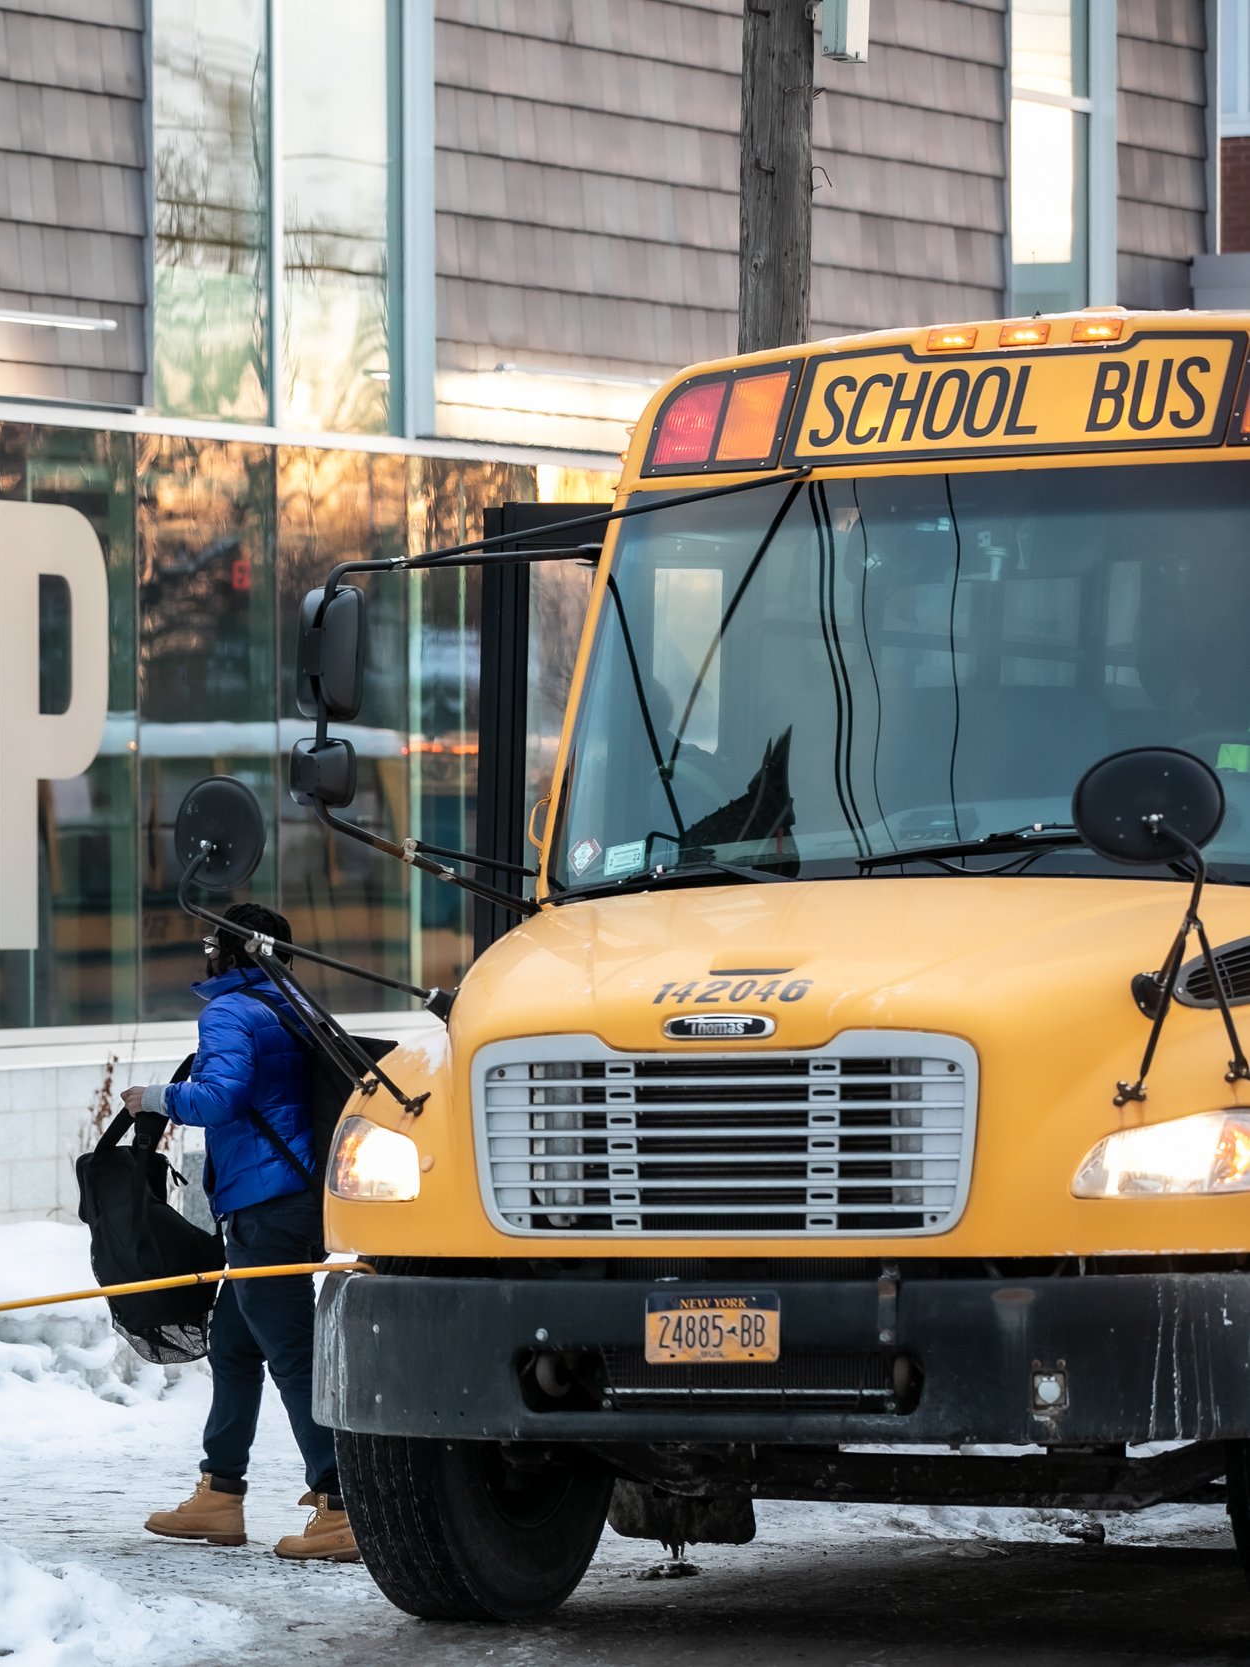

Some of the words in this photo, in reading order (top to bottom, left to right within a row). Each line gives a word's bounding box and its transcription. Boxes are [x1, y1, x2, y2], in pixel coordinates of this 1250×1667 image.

[808, 364, 1038, 448] SCHOOL
[1084, 355, 1211, 433] BUS
[652, 979, 814, 1005] 142046
[684, 1017, 753, 1035] Thomas
[679, 1298, 710, 1309] NEW
[713, 1298, 747, 1308] YORK
